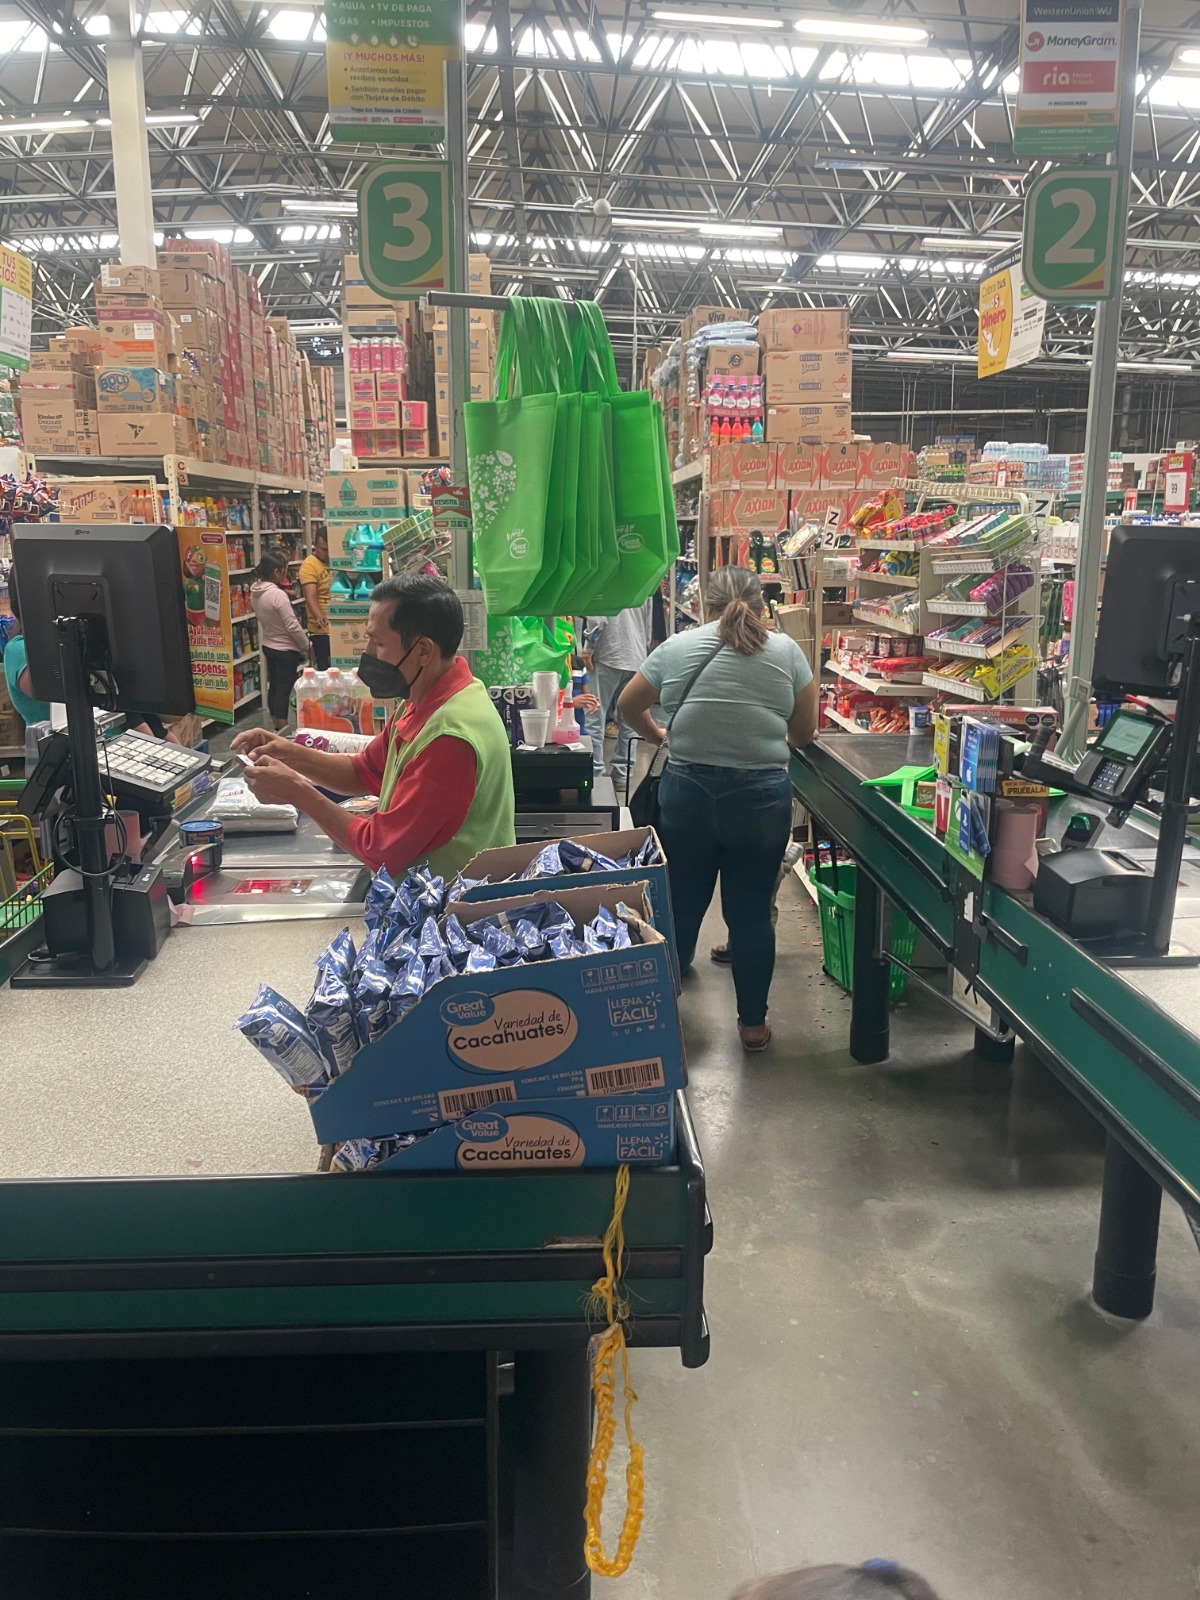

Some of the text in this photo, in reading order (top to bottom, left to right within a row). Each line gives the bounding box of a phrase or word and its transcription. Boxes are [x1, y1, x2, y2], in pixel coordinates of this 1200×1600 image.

[338, 2, 432, 13] AGUA TV DE PAGA
[339, 17, 430, 28] GAS IMPUESTOS
[355, 52, 398, 61] MUCHOS
[1043, 66, 1070, 86] ria
[382, 181, 432, 262] 3
[1043, 187, 1097, 264] 2
[2, 251, 16, 270] TUS
[997, 278, 1007, 289] tus
[980, 308, 1007, 331] Dinero
[100, 374, 129, 391] BOLD
[177, 461, 186, 470] C
[743, 460, 767, 473] AXION
[787, 460, 811, 473] AXION
[832, 459, 857, 473] AXION
[875, 460, 899, 473] AXION
[179, 474, 187, 483] 3
[744, 498, 776, 514] AXION
[805, 497, 837, 513] AXION
[828, 511, 839, 526] Z
[824, 532, 834, 545] 2
[217, 651, 230, 661] una
[191, 663, 228, 676] espensa
[205, 679, 214, 687] un
[216, 678, 228, 688] año
[446, 999, 485, 1014] Great
[610, 996, 643, 1009] LLENA
[457, 1009, 487, 1020] Value
[494, 1009, 562, 1031] Variedad de
[613, 1005, 654, 1024] FÁCIL
[453, 1023, 564, 1051] Cacahuates
[461, 1118, 500, 1131] Great
[642, 1120, 669, 1128] CUIDADO
[471, 1129, 500, 1137] Value
[504, 1135, 571, 1148] Variedad de
[619, 1136, 650, 1145] LLENA
[462, 1145, 571, 1162] Cacahuates
[619, 1142, 660, 1158] FÁCIL
